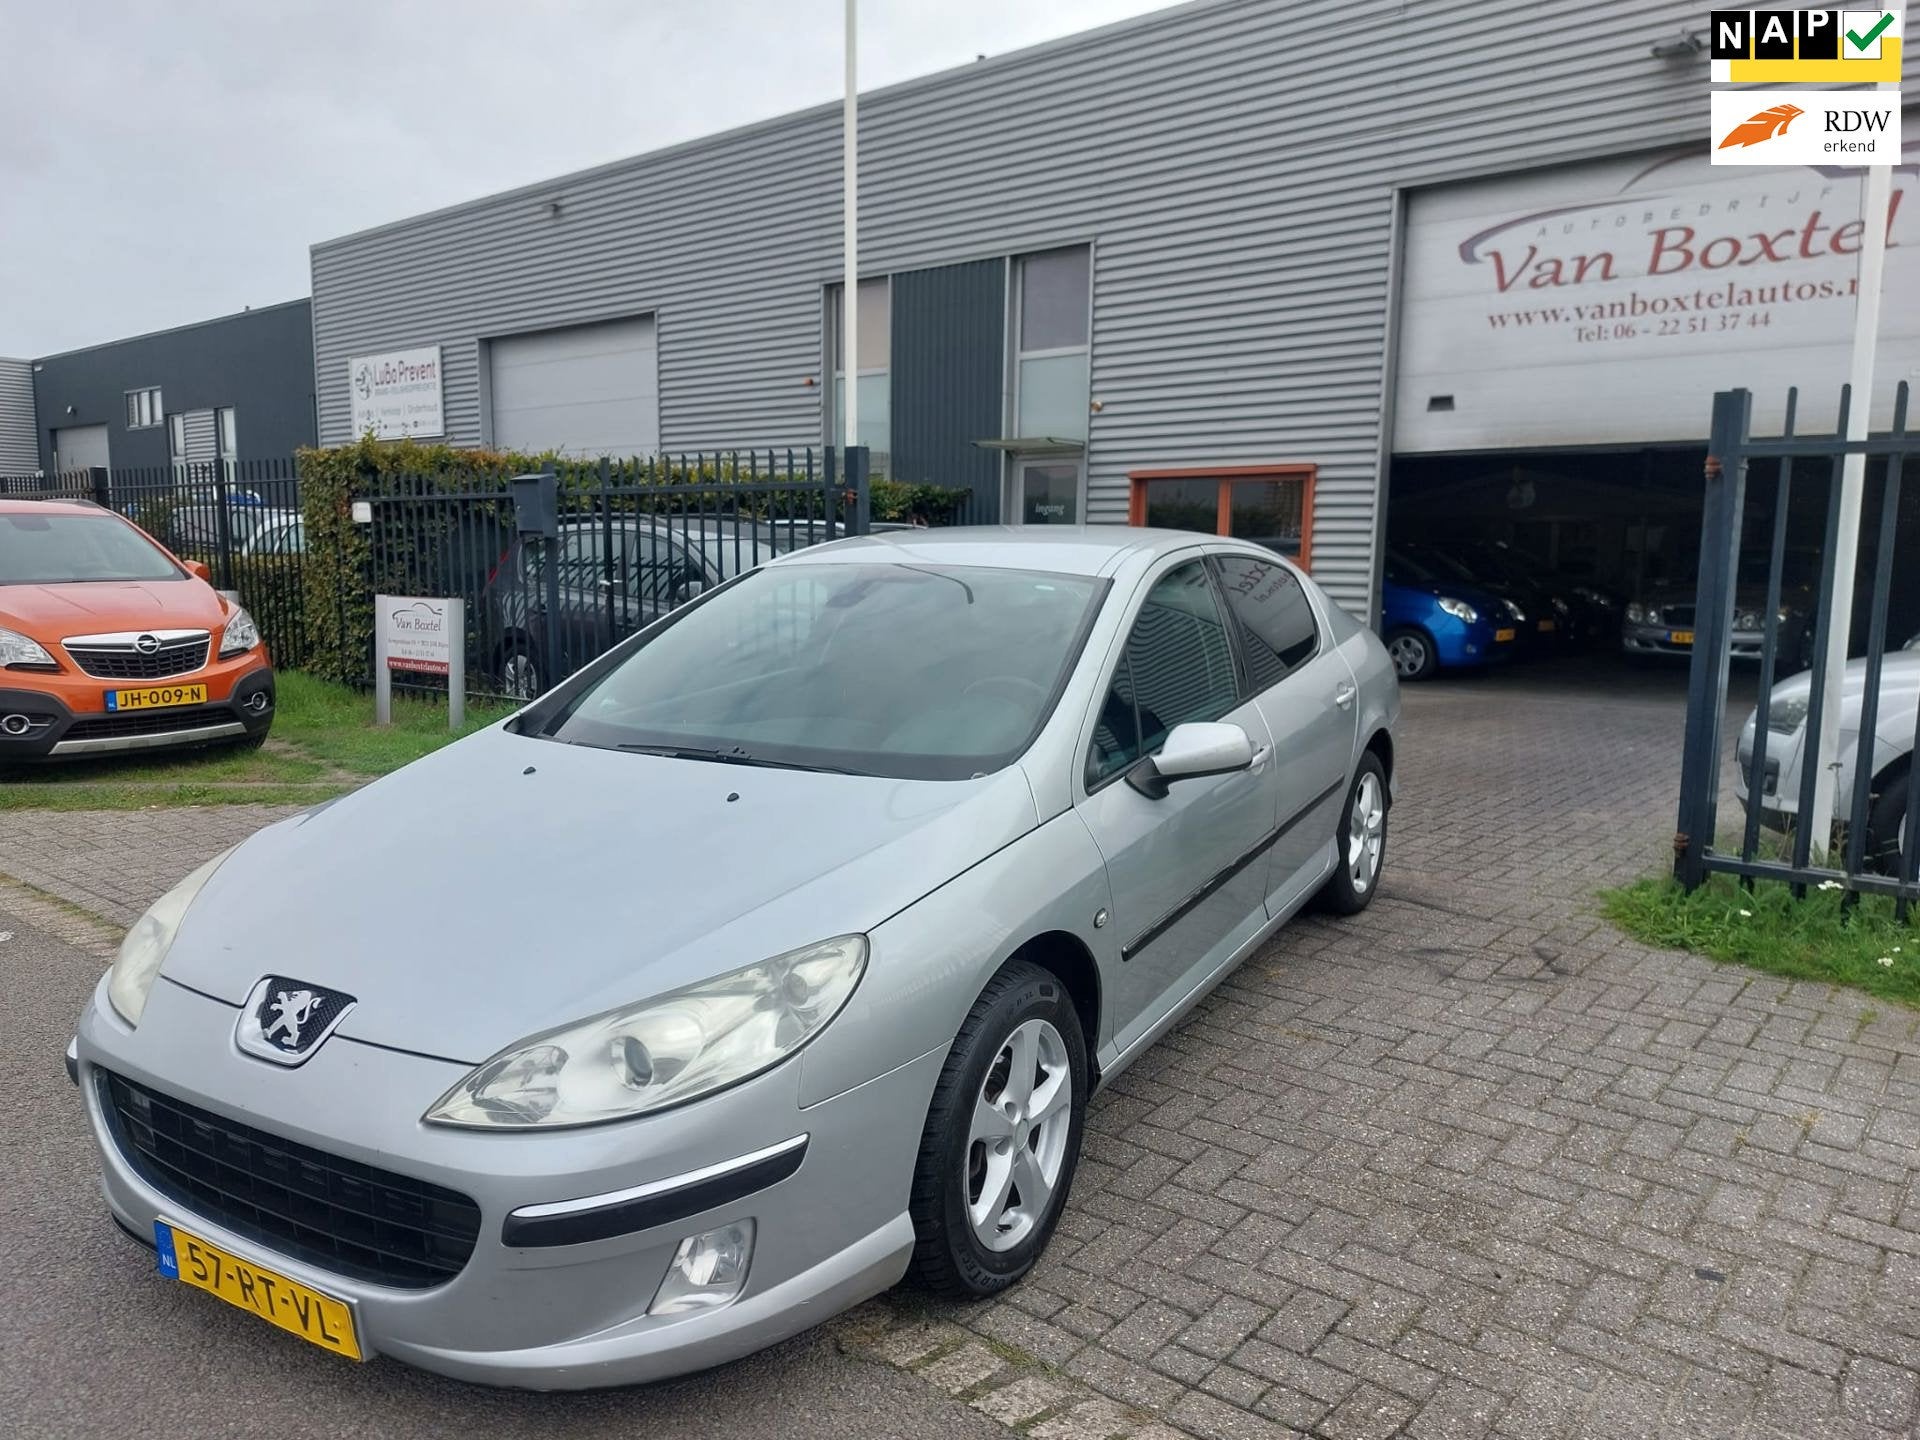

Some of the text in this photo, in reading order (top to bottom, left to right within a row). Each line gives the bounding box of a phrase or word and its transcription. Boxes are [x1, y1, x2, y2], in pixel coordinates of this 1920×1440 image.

[1484, 189, 1904, 293] Van Boxtel
[1488, 278, 1858, 329] www.vanboxtelautos.
[1575, 325, 1608, 343] Tel:
[1613, 323, 1636, 340] 06
[1657, 319, 1680, 336] 22
[1688, 317, 1707, 332] 51
[1719, 314, 1740, 331] 37
[1748, 312, 1771, 328] 44
[395, 616, 442, 632] Van Boxtel
[120, 687, 200, 707] JH-009-N
[162, 1241, 340, 1345] NL 57-RT-VL
